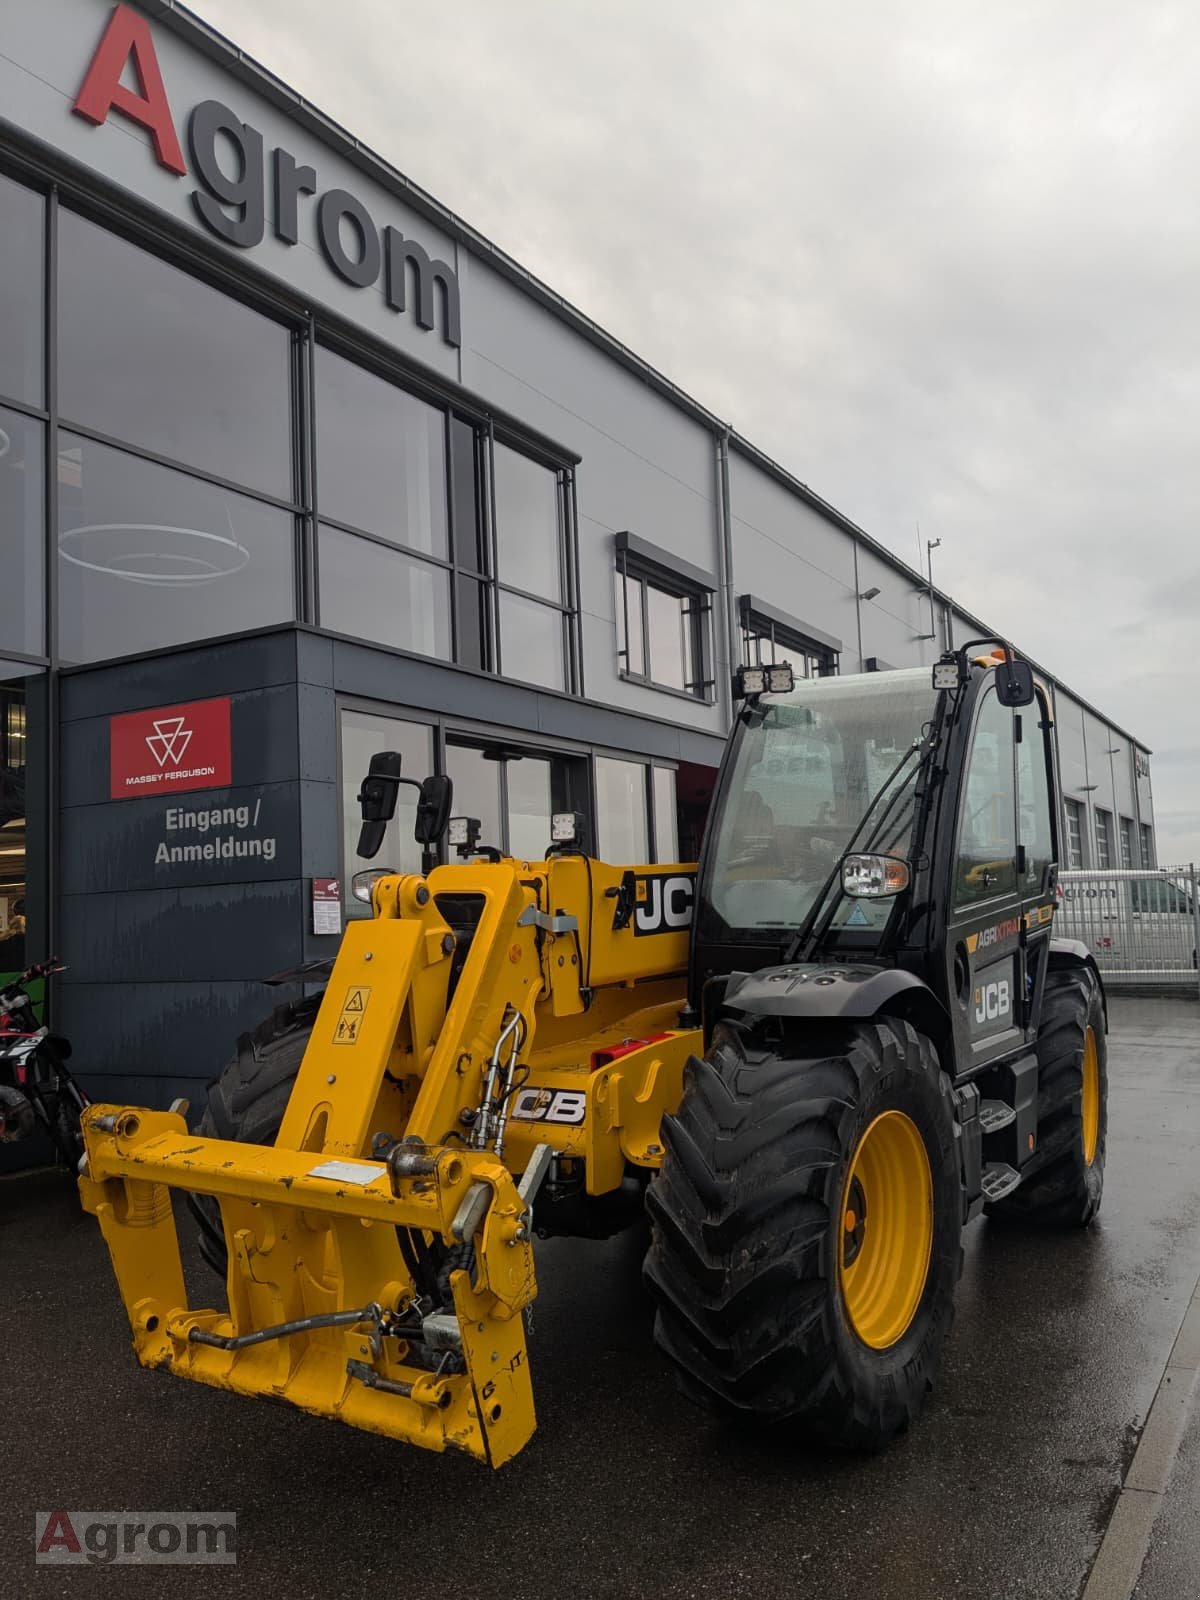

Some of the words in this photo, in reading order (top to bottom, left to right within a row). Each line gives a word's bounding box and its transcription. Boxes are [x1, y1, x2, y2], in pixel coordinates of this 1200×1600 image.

[72, 4, 461, 348] Agrom
[126, 774, 163, 785] MASSEY
[165, 767, 215, 780] FERGUSON
[166, 806, 249, 832] Eingang
[155, 836, 276, 864] Anmeldung
[636, 877, 697, 930] JC
[1056, 883, 1116, 902] Agrom
[975, 980, 1010, 1023] JCB
[511, 1089, 586, 1123] CB
